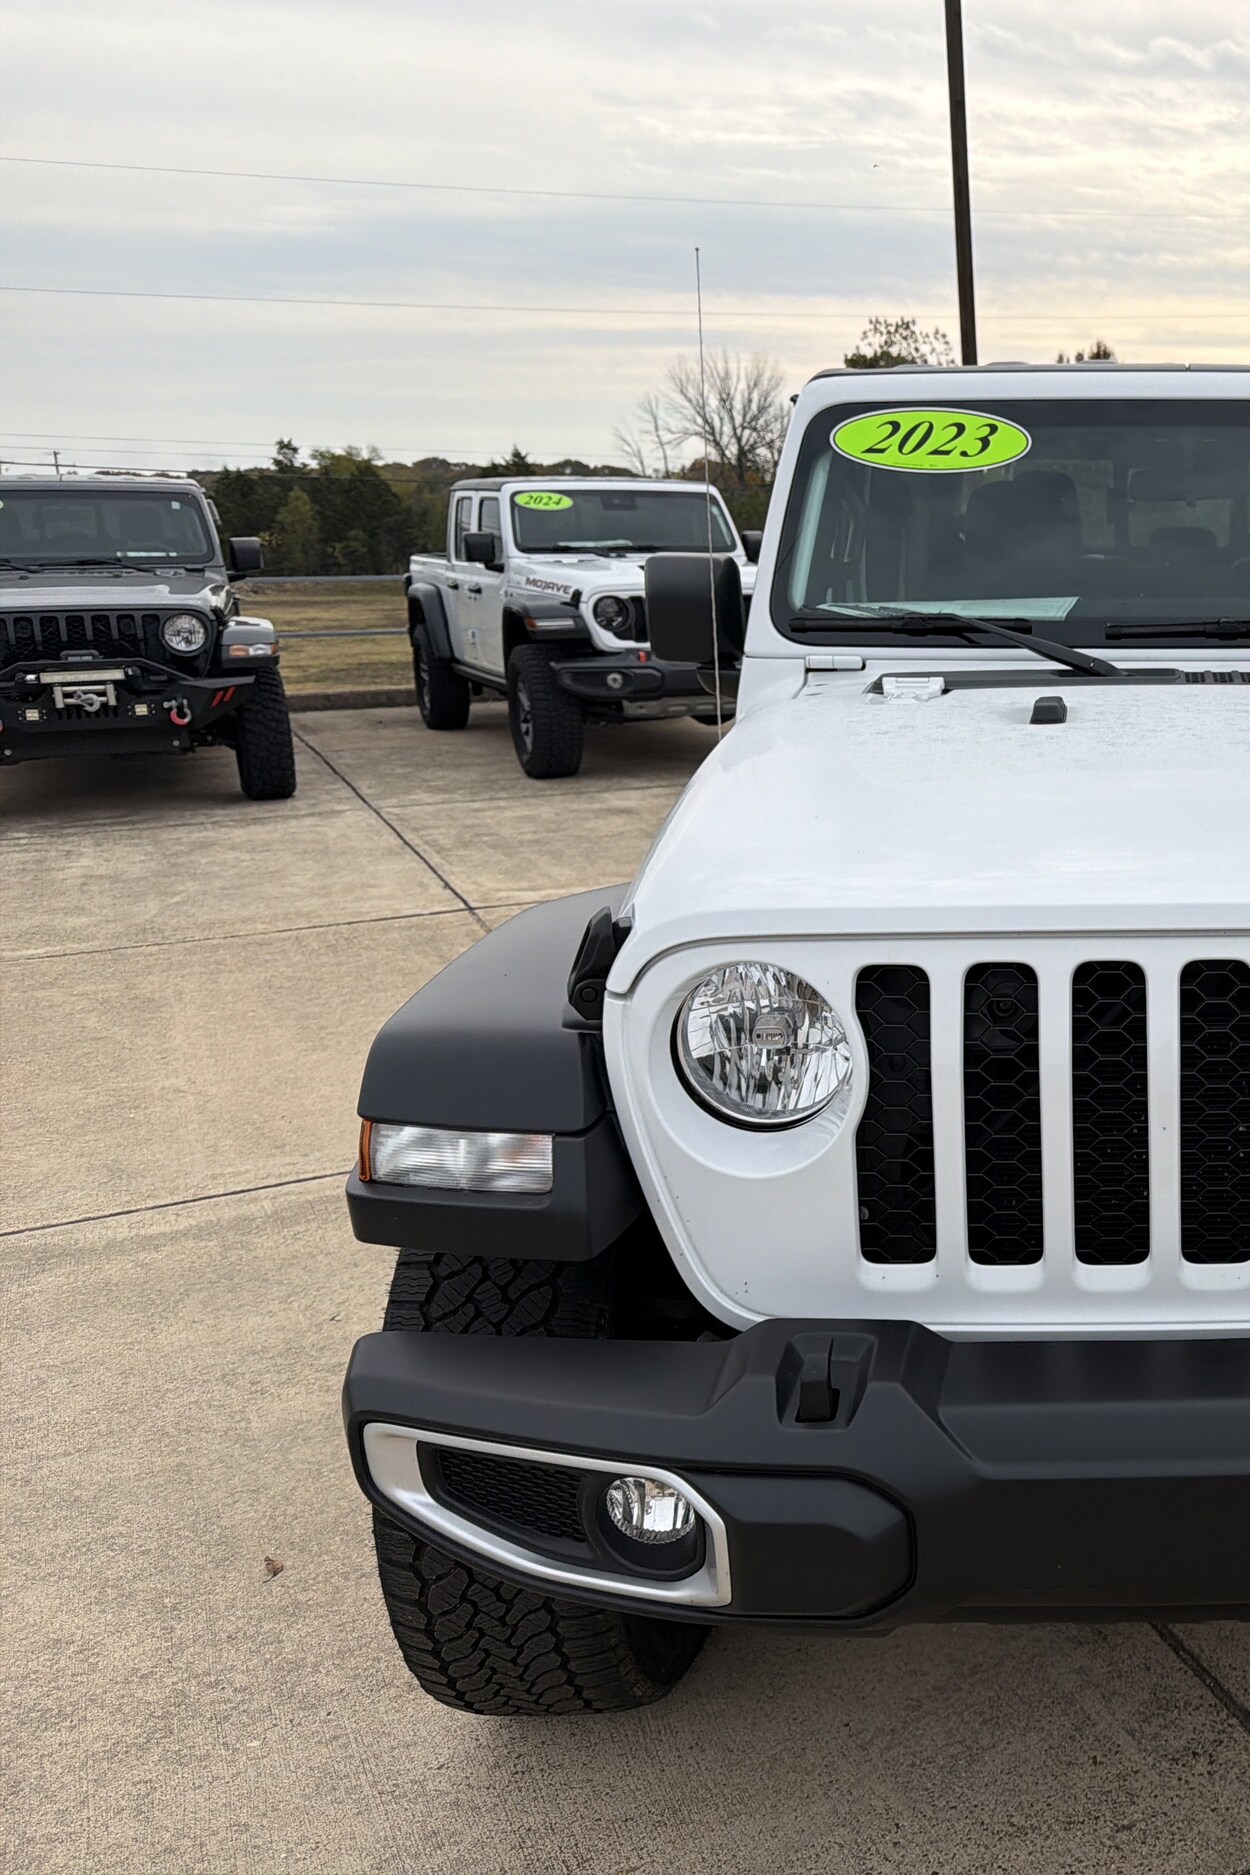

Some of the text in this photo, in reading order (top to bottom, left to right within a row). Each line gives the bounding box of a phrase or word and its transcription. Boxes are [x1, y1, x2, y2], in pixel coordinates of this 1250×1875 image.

[861, 420, 999, 457] 2023
[523, 494, 563, 506] 2024
[525, 577, 572, 595] MOJAVE
